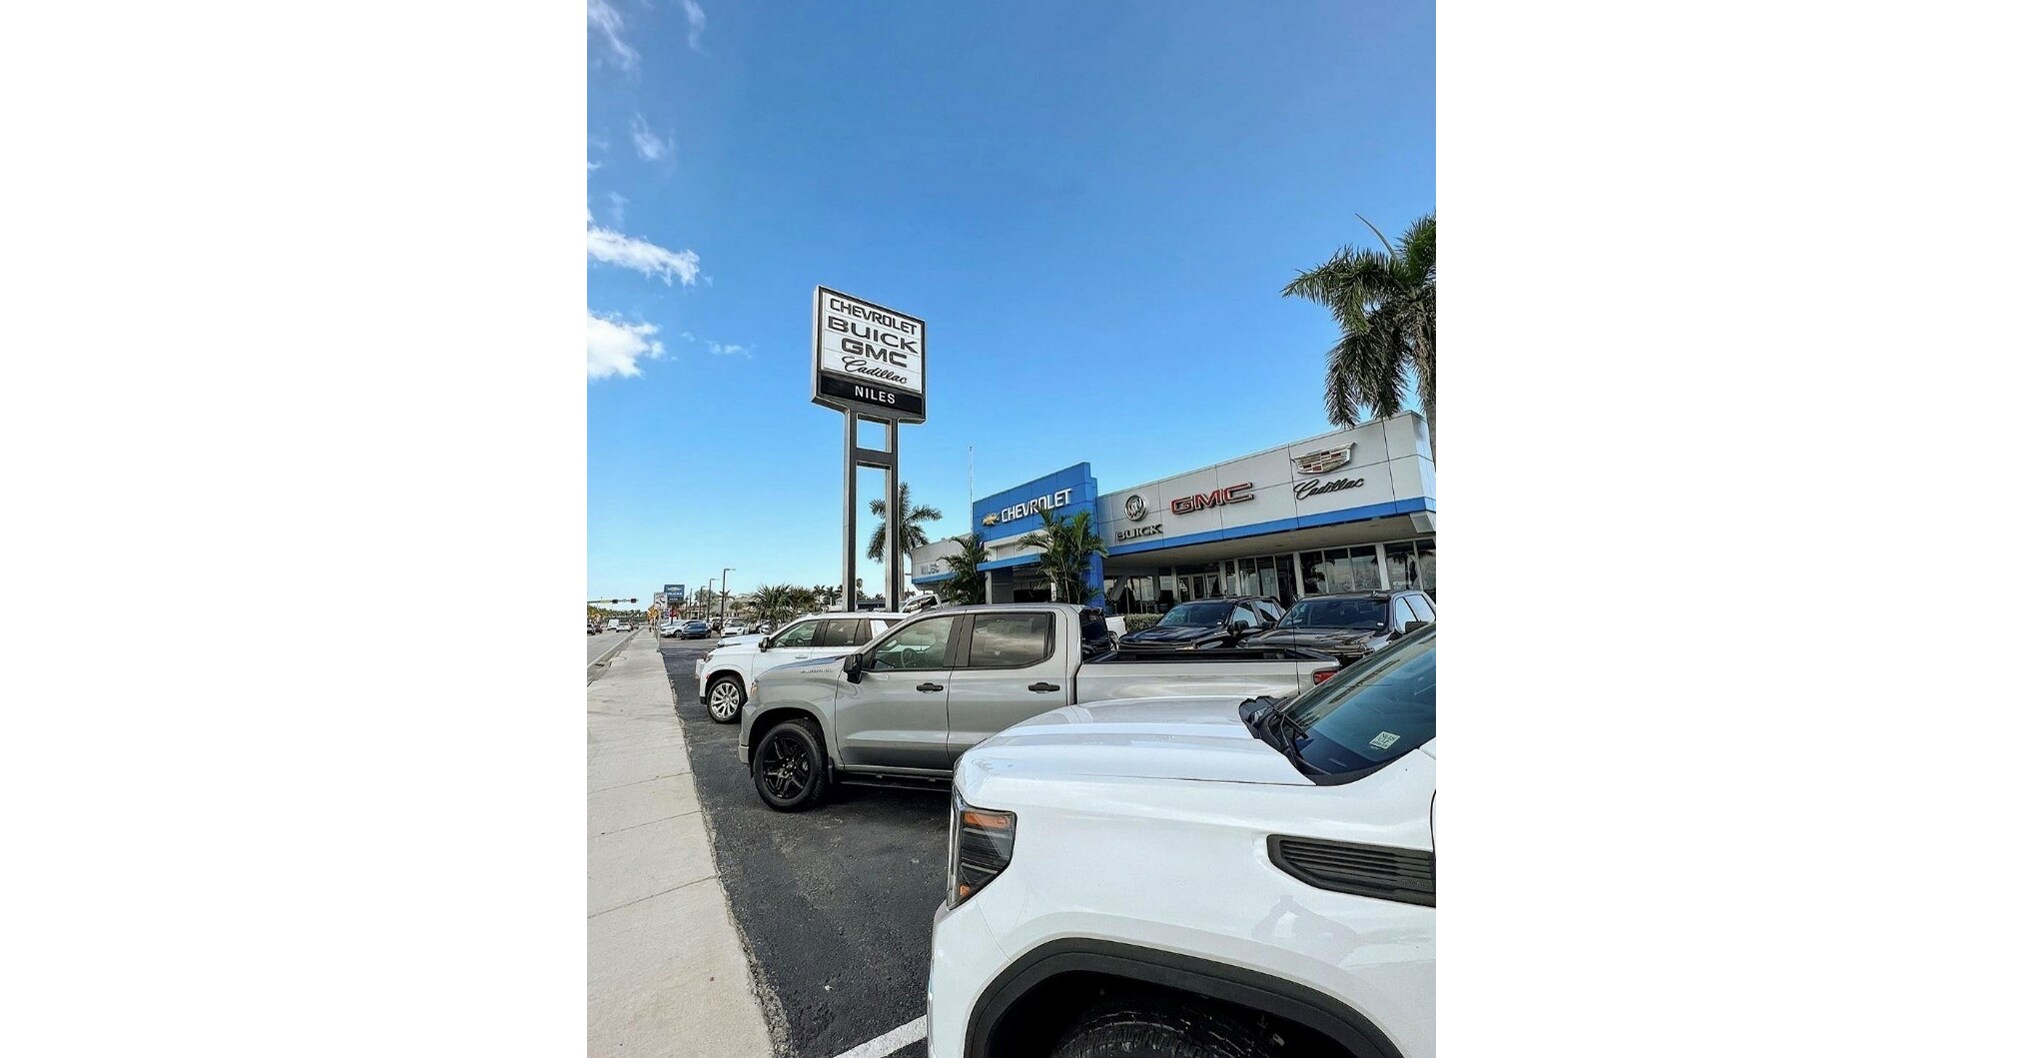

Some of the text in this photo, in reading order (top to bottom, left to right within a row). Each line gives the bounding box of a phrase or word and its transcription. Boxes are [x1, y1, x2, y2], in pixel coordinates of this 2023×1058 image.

[830, 298, 917, 335] CHEVROLET
[828, 315, 918, 354] BUICK
[841, 337, 907, 368] GMC
[841, 355, 907, 384] Cadillac
[855, 385, 895, 404] NILES
[1170, 481, 1254, 515] GMC
[1293, 477, 1364, 501] Cadillac
[1001, 488, 1073, 523] CHEVROLET
[1115, 523, 1163, 541] BUICK
